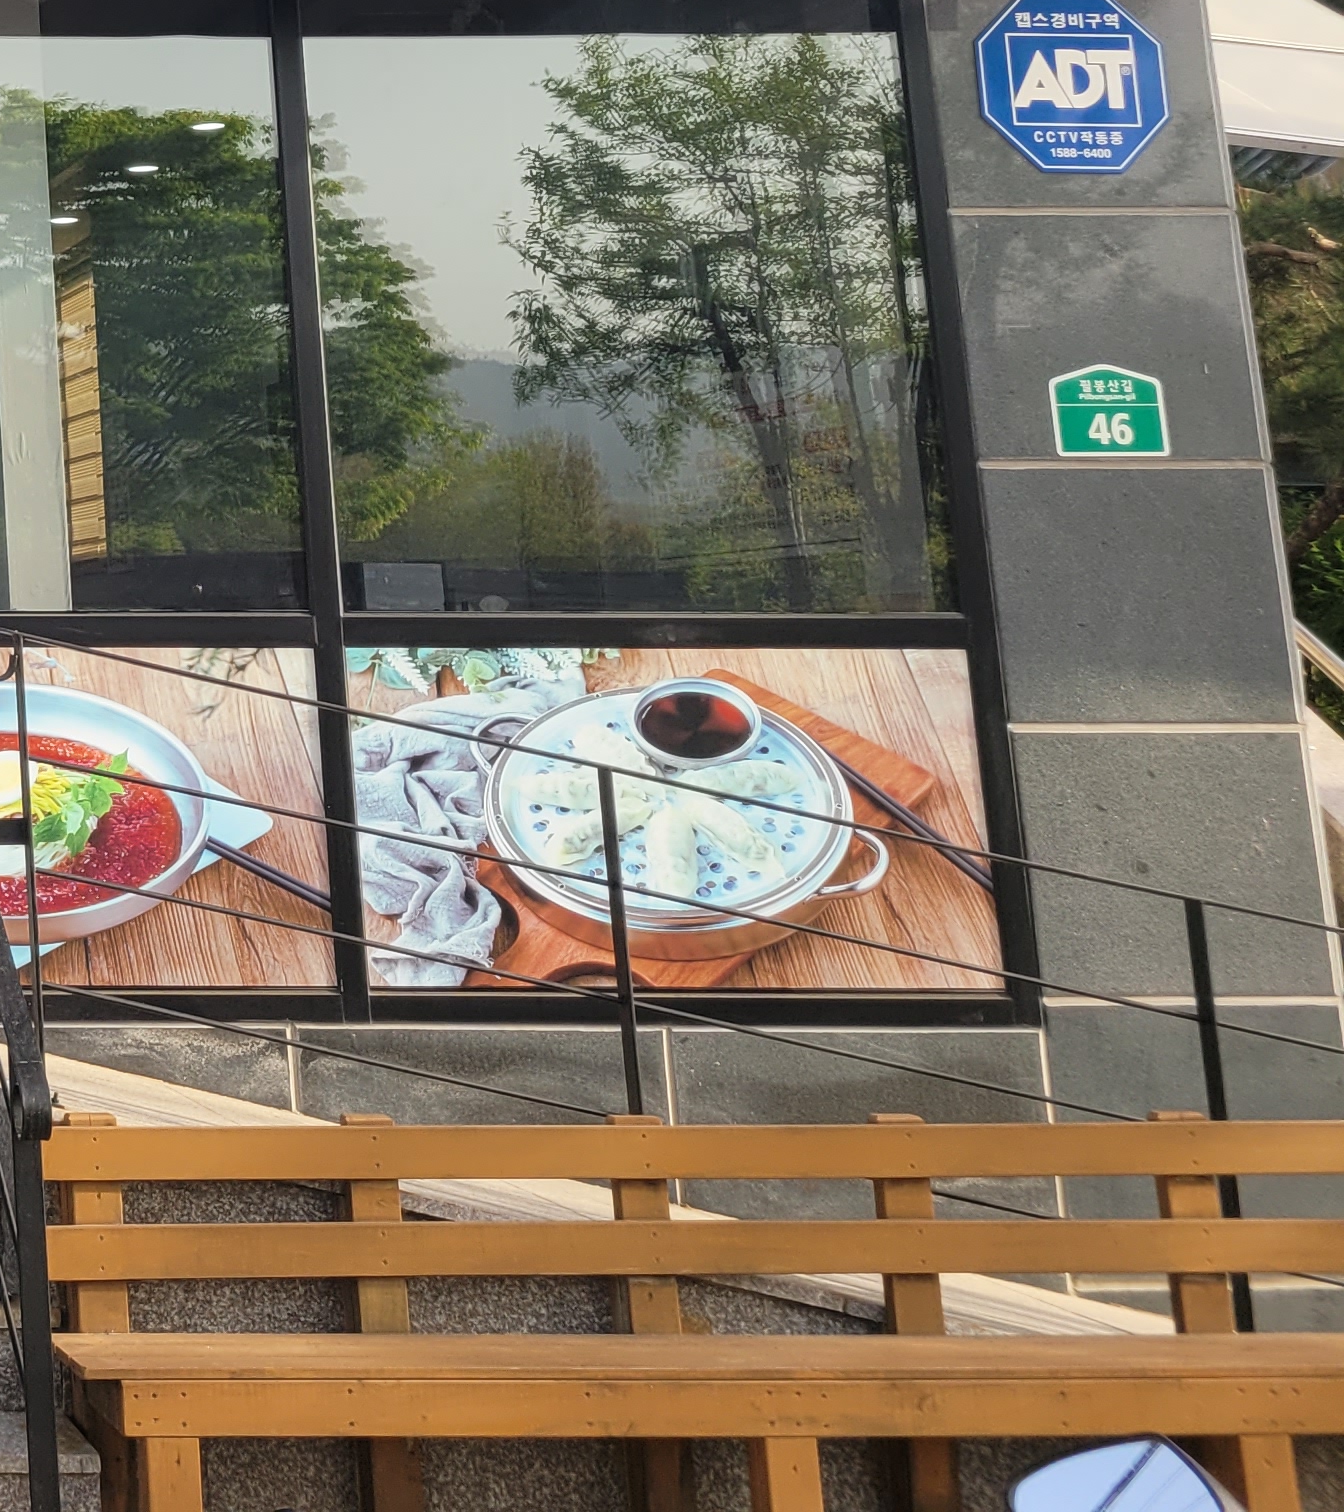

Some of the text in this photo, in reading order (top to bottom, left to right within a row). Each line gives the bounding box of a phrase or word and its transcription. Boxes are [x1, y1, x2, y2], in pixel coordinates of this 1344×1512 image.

[1014, 12, 1121, 29] 캡스경비구역
[1014, 48, 1133, 109] ADT
[1033, 131, 1124, 145] CCTV작동중
[1049, 147, 1112, 159] 1588-6400
[1088, 412, 1134, 445] 46
